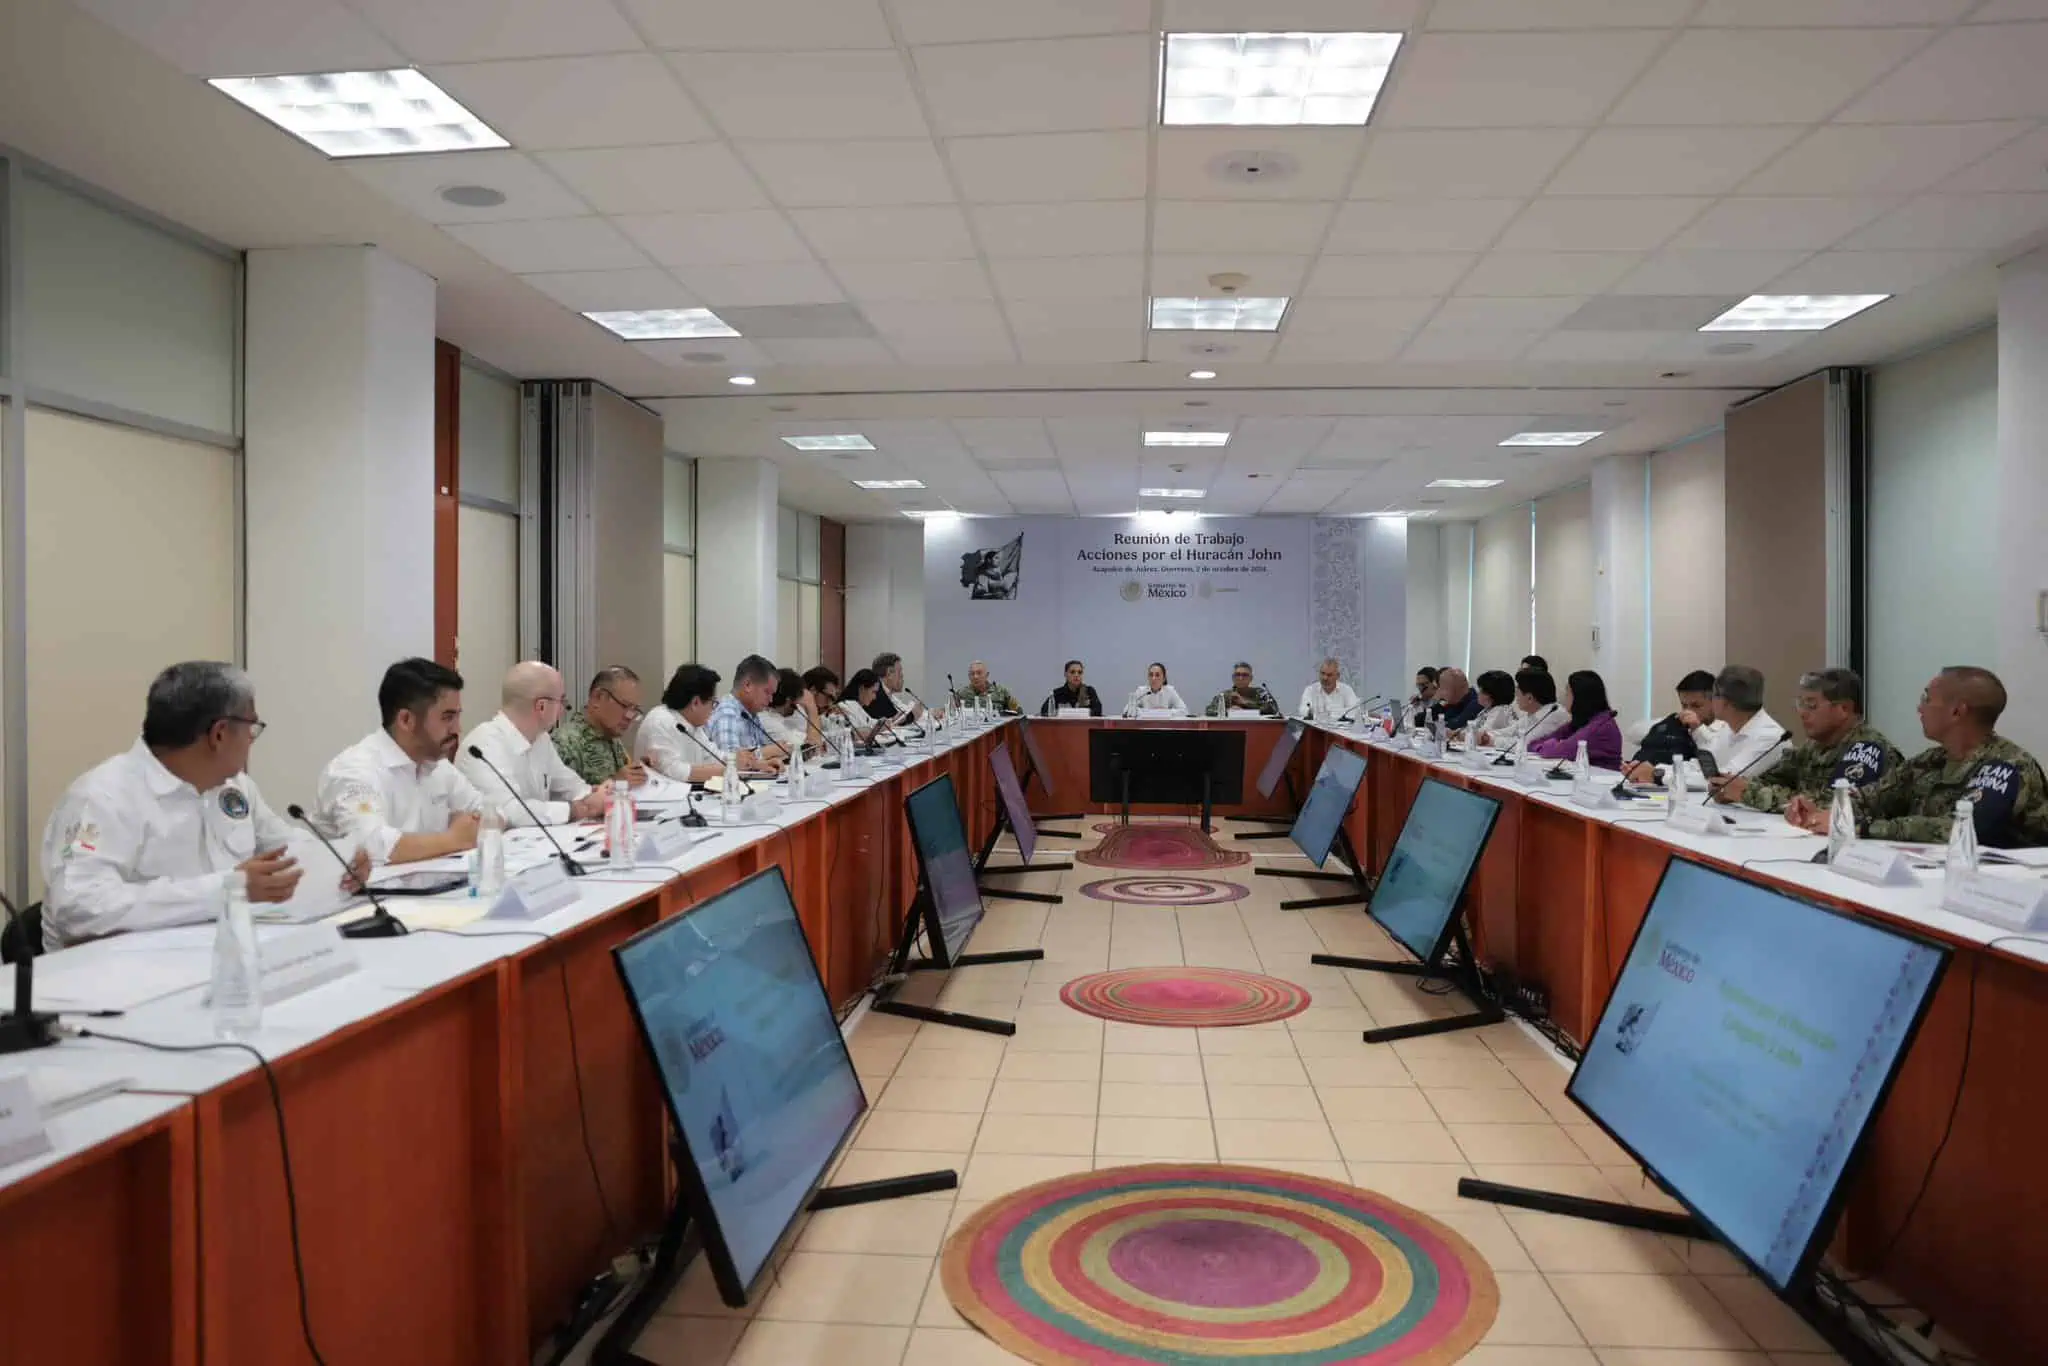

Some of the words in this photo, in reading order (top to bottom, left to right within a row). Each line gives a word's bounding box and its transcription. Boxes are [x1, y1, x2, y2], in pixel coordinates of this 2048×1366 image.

[1114, 532, 1170, 545] Reunión
[1175, 533, 1191, 545] de
[1195, 533, 1245, 547] Trabajo
[1077, 549, 1138, 561] Acciones
[1142, 551, 1166, 563] por
[1170, 549, 1182, 561] el
[1186, 548, 1244, 561] Huracán
[1247, 549, 1282, 561] John
[1147, 587, 1187, 598] México
[1851, 742, 1881, 760] PLAN
[1843, 751, 1879, 773] MARINA
[1978, 764, 2013, 780] PLAN
